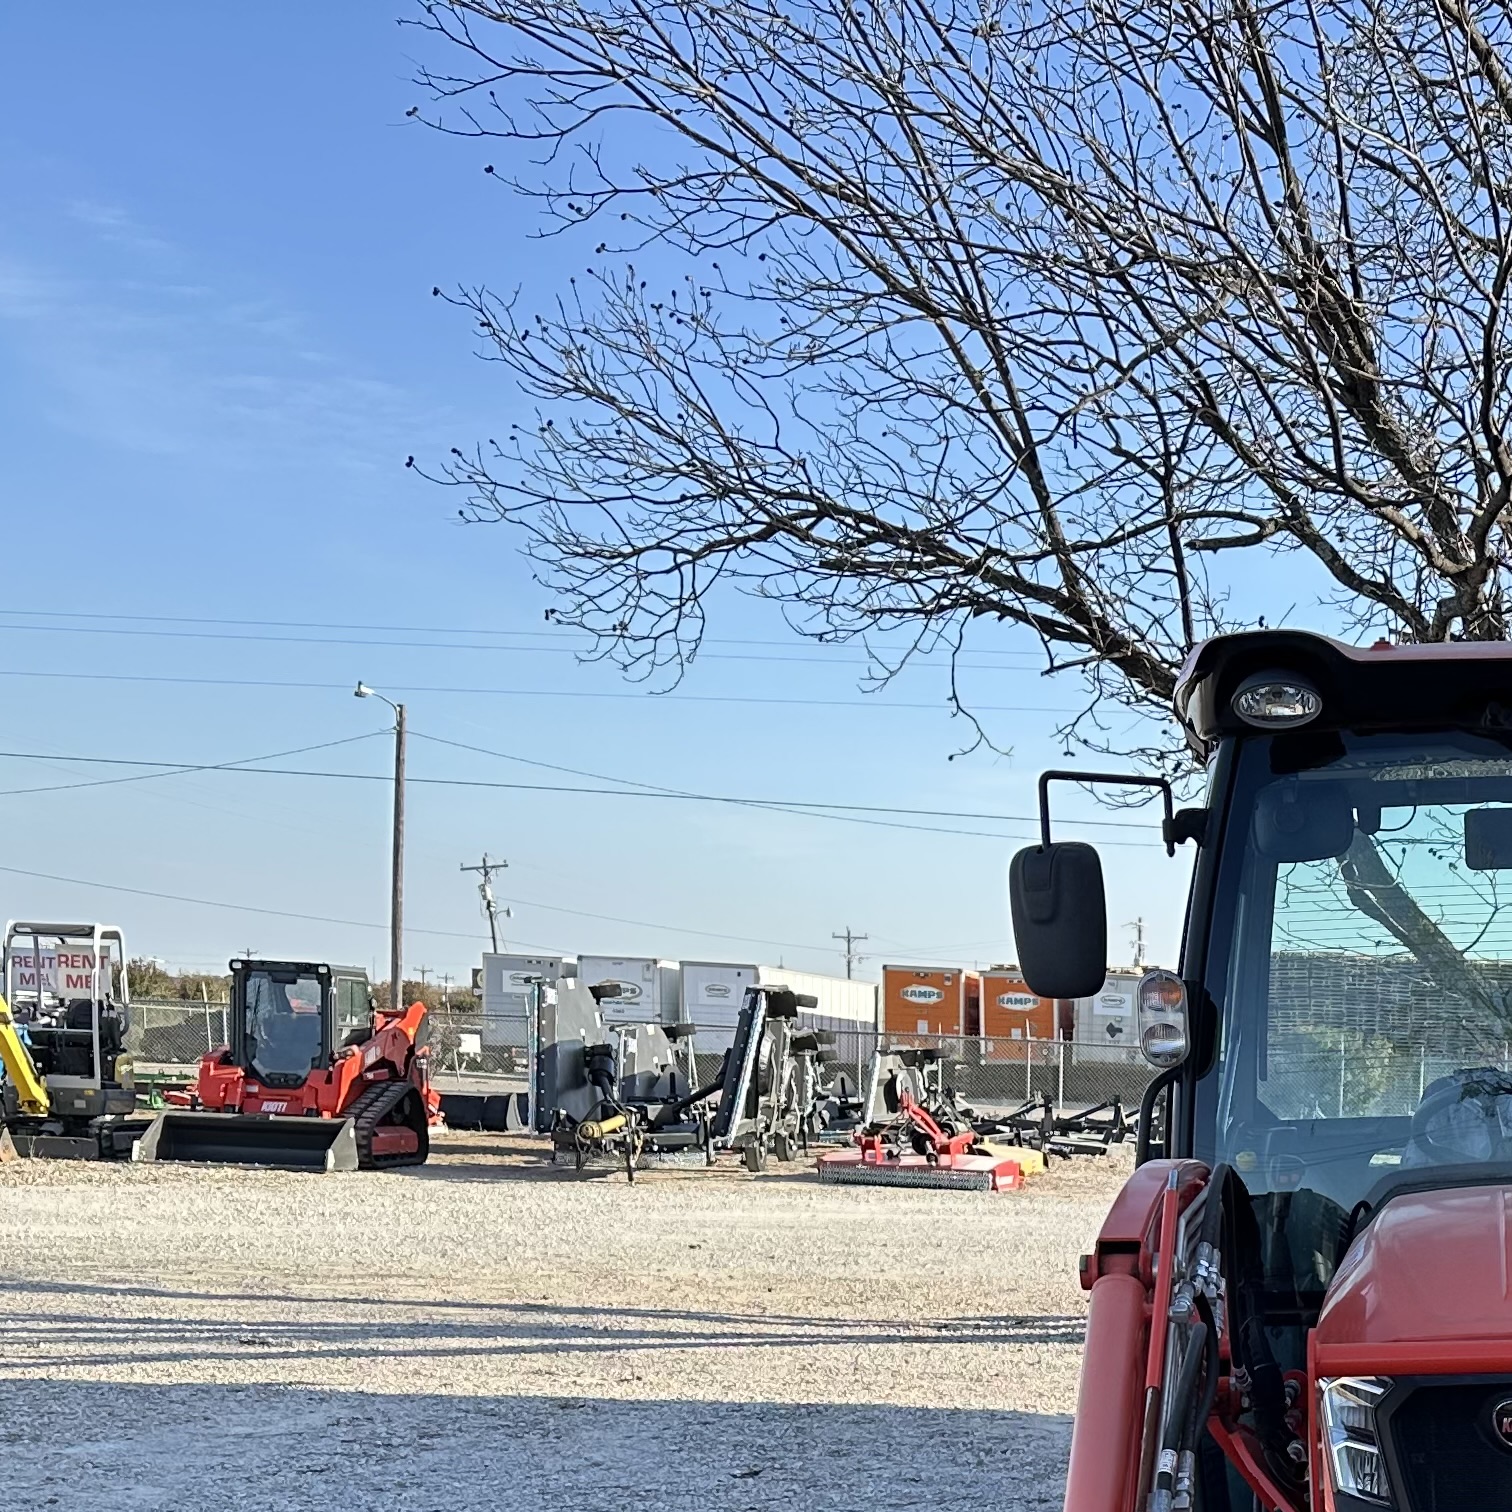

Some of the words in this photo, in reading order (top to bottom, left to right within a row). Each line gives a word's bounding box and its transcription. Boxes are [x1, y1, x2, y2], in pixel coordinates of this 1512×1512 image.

[57, 953, 109, 970] RENT
[902, 989, 943, 999] KAMPS
[997, 996, 1040, 1006] KAMPS
